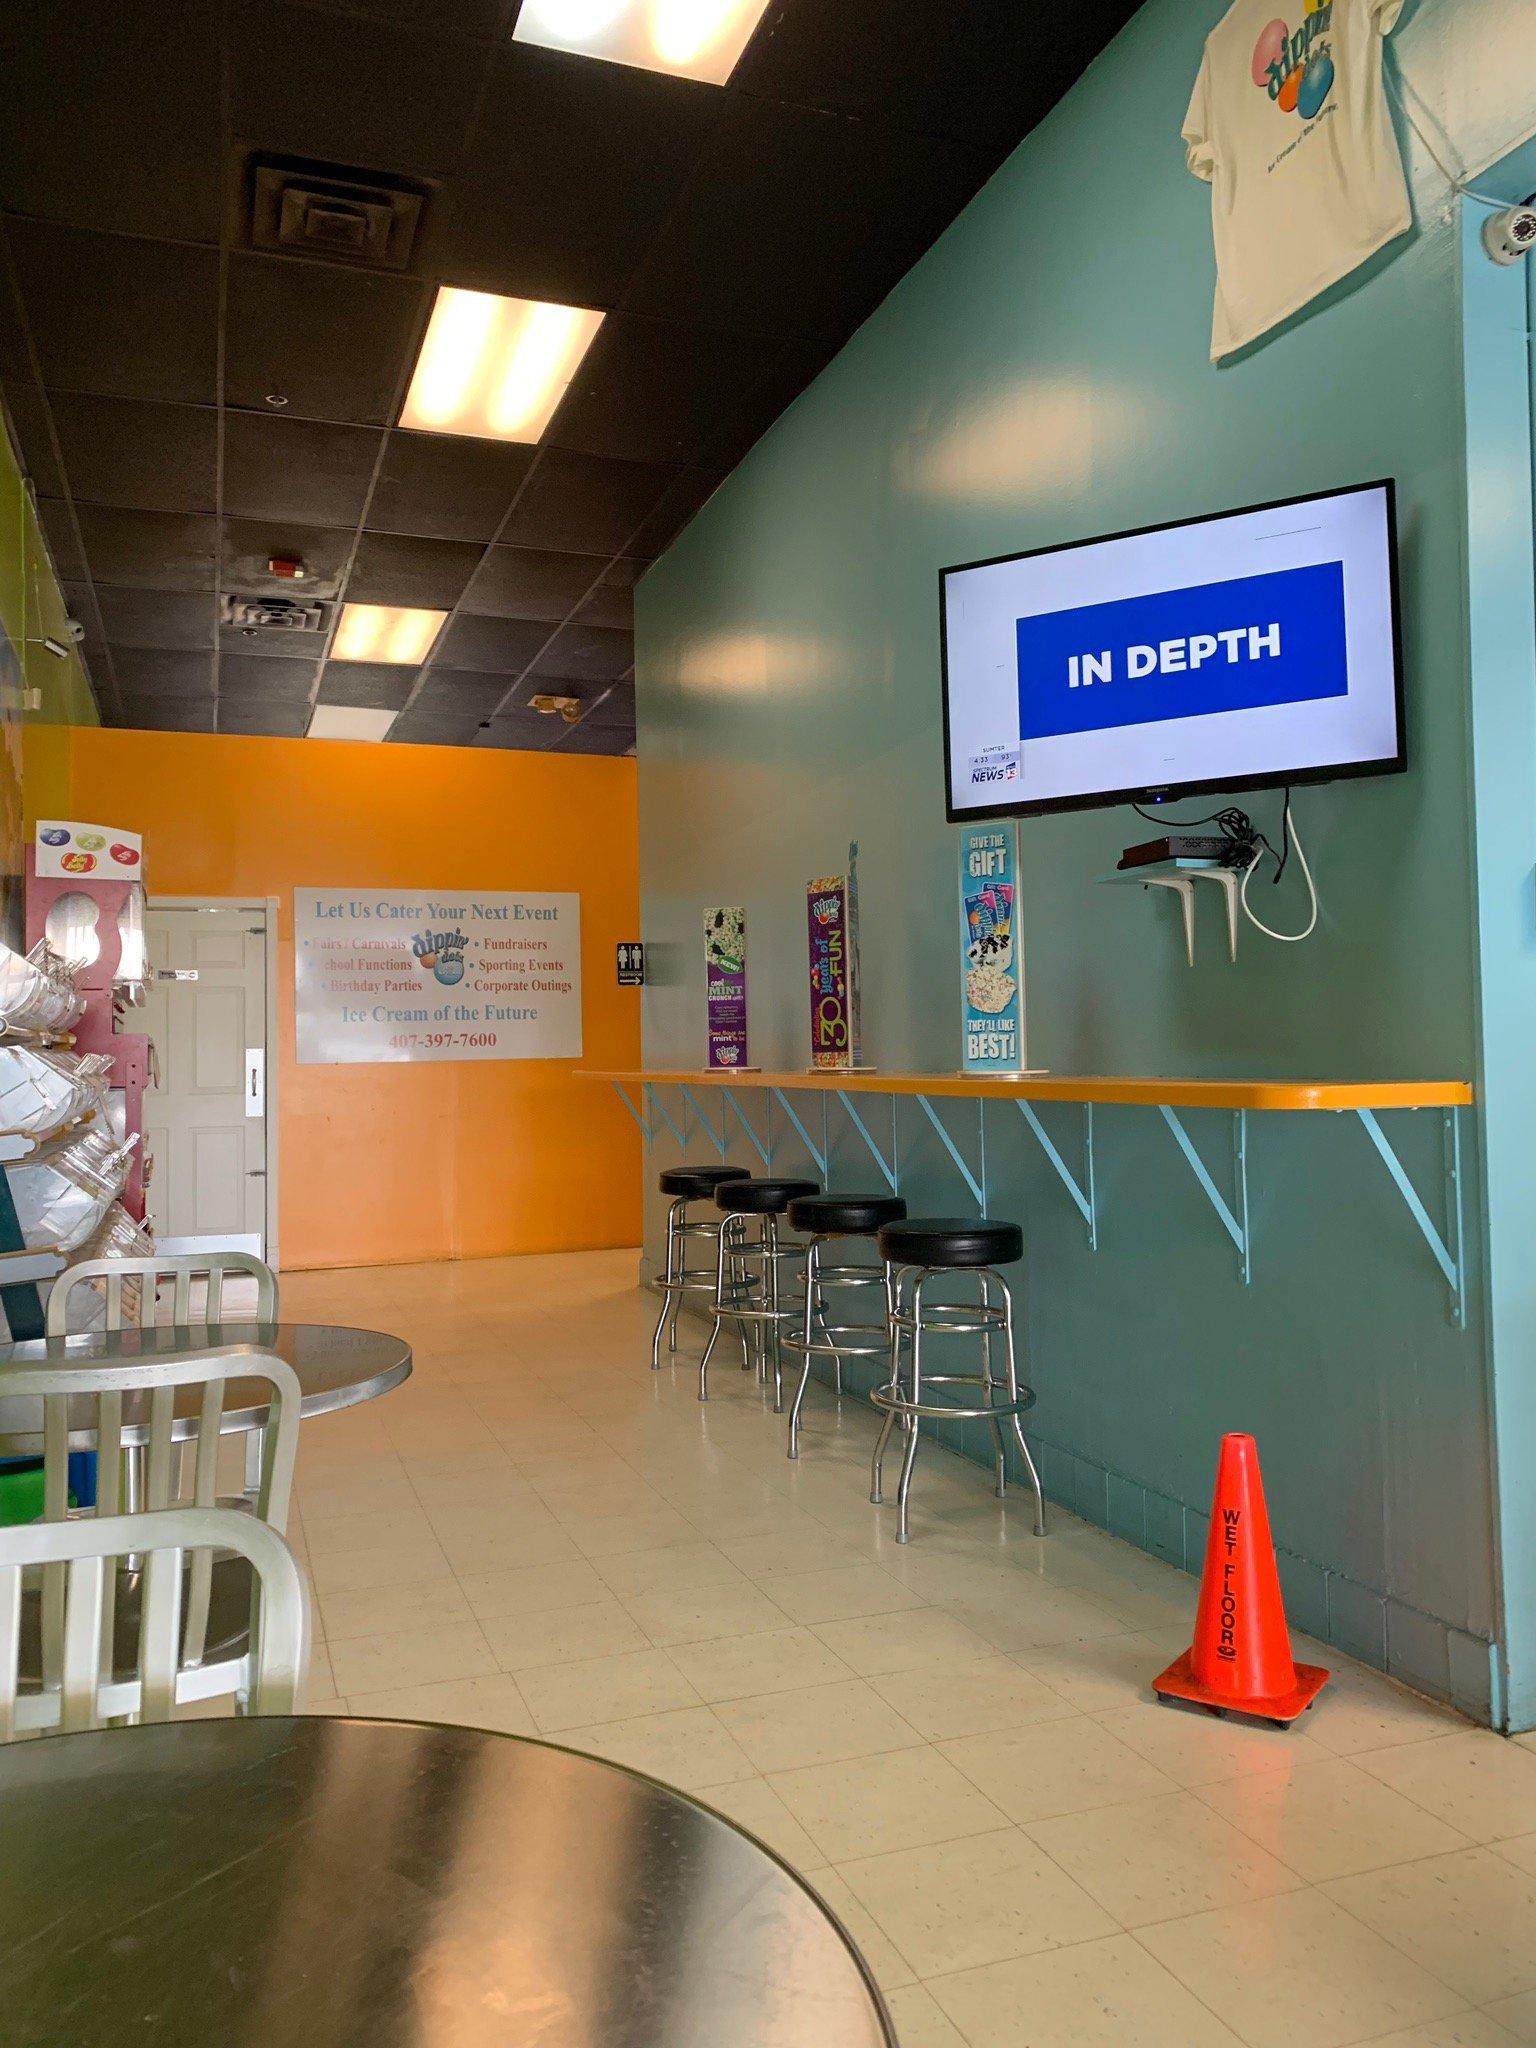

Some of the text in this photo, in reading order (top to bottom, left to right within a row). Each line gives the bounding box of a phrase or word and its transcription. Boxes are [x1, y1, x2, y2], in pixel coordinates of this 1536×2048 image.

[1067, 622, 1281, 689] IN DEPTH
[971, 769, 1005, 783] NEWS
[969, 833, 1005, 850] GIVE THE
[968, 848, 1007, 879] GIFT
[315, 901, 560, 921] Let Us Cater Your Next Event
[351, 937, 407, 950] Carnivals
[483, 938, 548, 950] Fundraisers
[828, 929, 844, 977] FUN
[357, 958, 413, 971] Functions
[478, 958, 564, 974] Sporting Events
[814, 937, 834, 995] years of
[329, 979, 424, 994] Birthday Parties
[473, 979, 572, 995] Corporate Outings
[708, 985, 743, 996] MINT
[341, 1004, 539, 1023] Ice Cream of the Future
[818, 996, 848, 1047] 30
[967, 1018, 1016, 1033] THEY'LL LIKE
[389, 1032, 498, 1049] 407-397-7600
[967, 1032, 1016, 1060] BEST!
[1220, 1508, 1241, 1646] WET FLOOR
